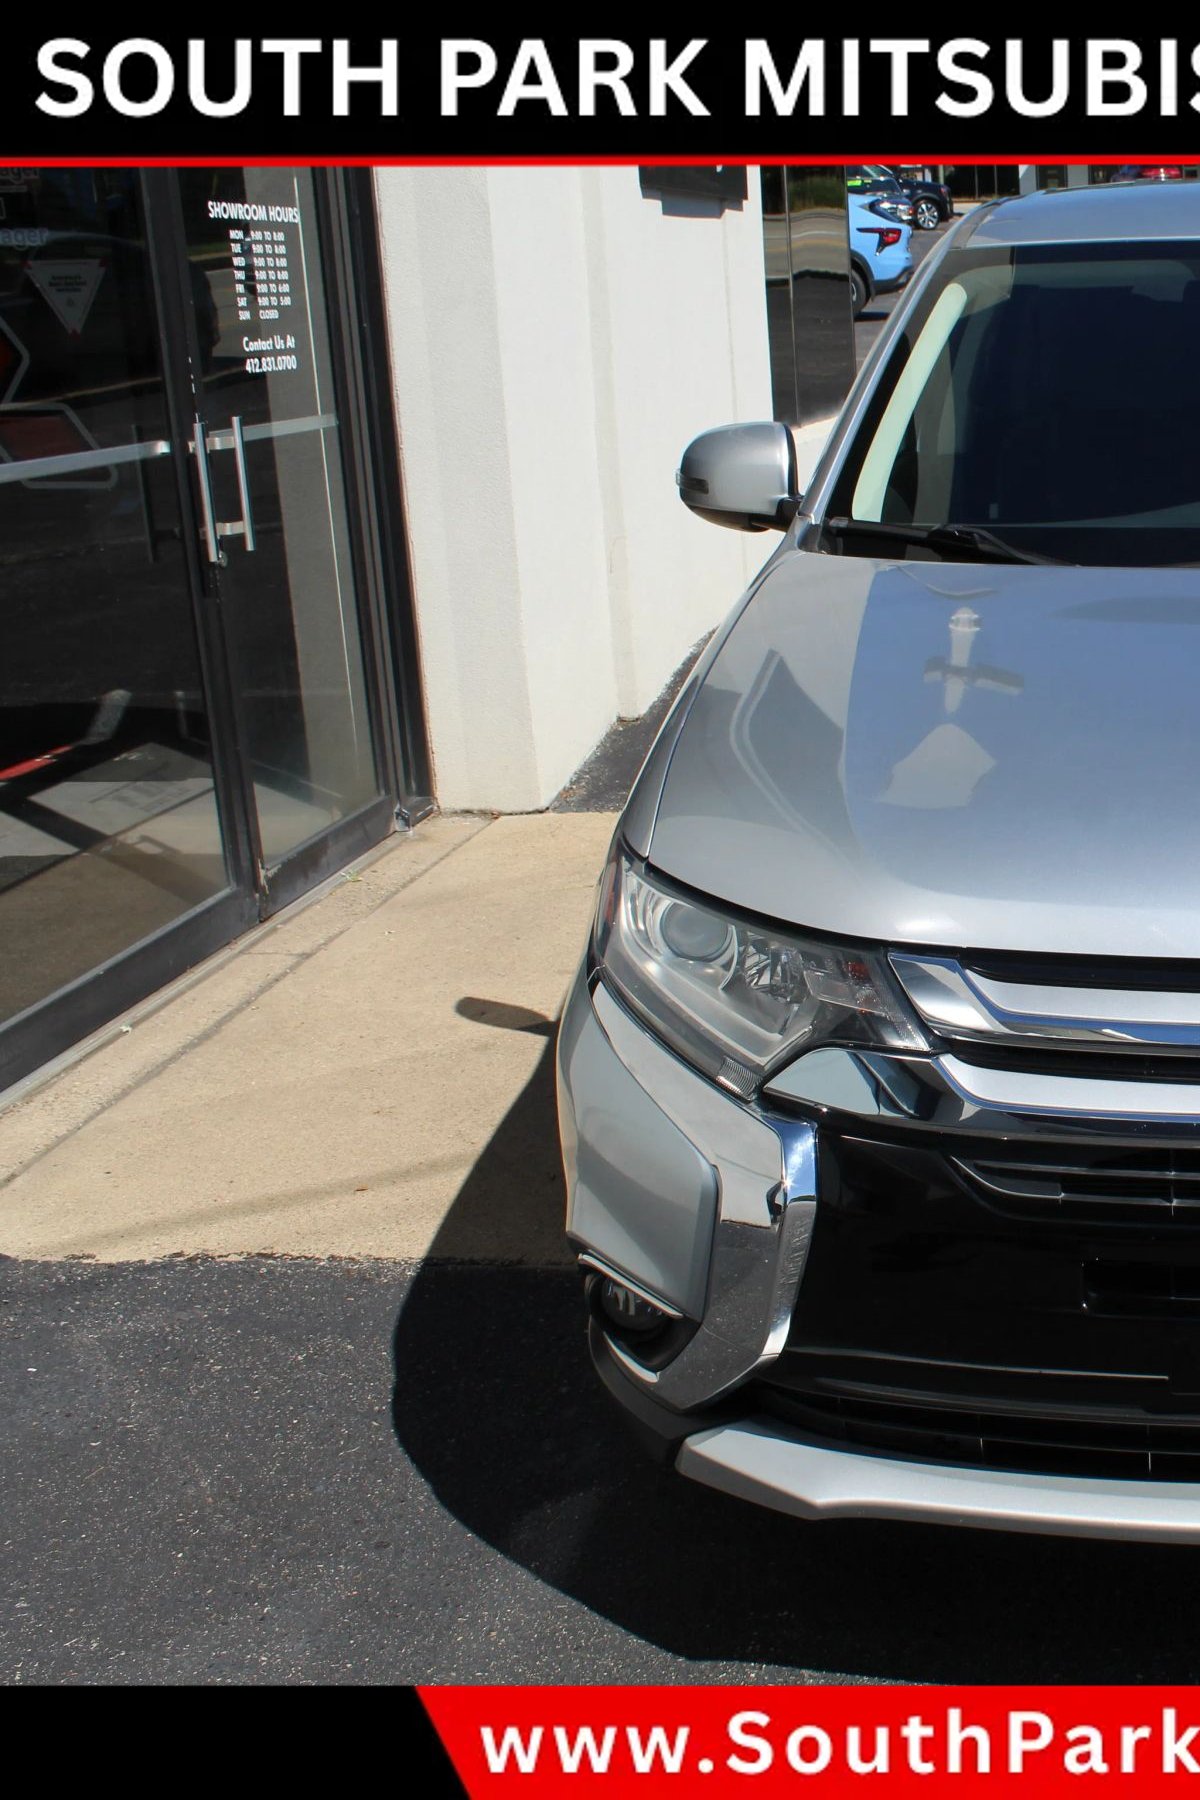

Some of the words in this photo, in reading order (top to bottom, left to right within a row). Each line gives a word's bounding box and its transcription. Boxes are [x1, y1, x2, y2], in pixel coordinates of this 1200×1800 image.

[208, 200, 267, 221] SHOWROOM
[268, 205, 299, 223] HOURS
[229, 230, 244, 240] MON
[264, 231, 272, 240] TO
[230, 243, 242, 253] TUE
[265, 244, 272, 254] TO
[232, 257, 246, 266] WED
[266, 258, 274, 267] TO
[234, 270, 246, 280] THU
[268, 270, 276, 280] TO
[236, 284, 244, 294] FRI
[269, 284, 277, 293] TO
[237, 297, 247, 307] SAT
[270, 296, 278, 306] TO
[238, 310, 250, 320] SUN
[259, 310, 279, 320] CLOSED
[243, 337, 273, 352] Contact
[274, 335, 284, 349] Us
[286, 334, 296, 348] At
[246, 354, 297, 374] 412.831.0700
